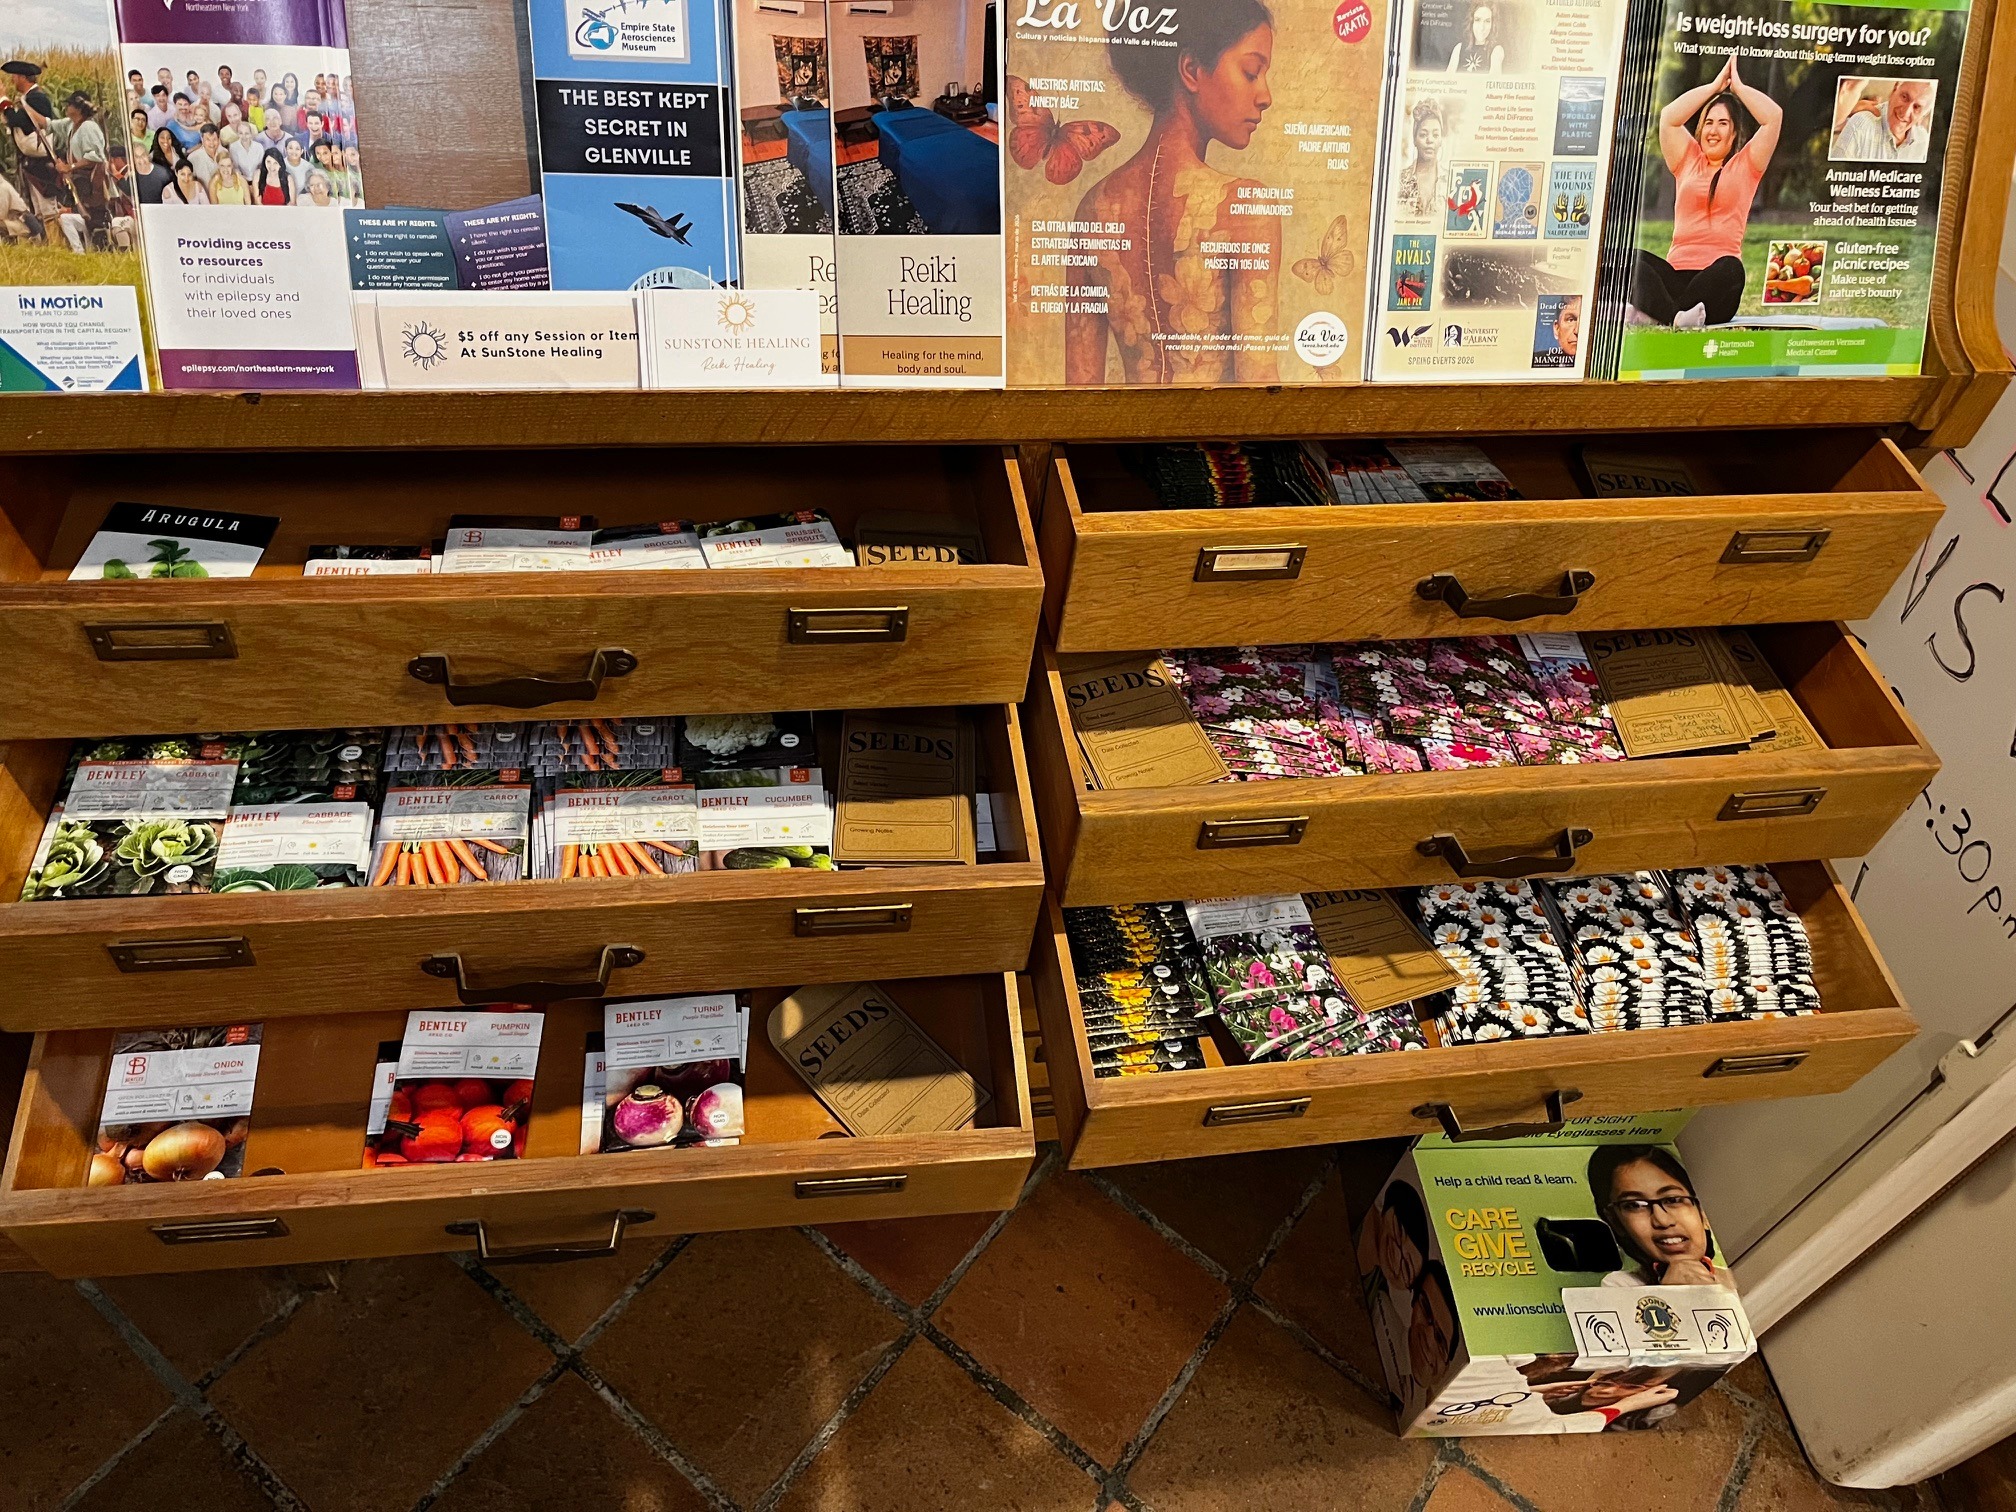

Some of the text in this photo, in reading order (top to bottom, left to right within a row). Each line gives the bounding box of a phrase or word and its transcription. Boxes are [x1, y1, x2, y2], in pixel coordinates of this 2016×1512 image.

[1016, 0, 1179, 35] La Voz
[1338, 12, 1369, 36] GRATIS
[620, 23, 676, 34] Empire State
[1676, 11, 1932, 48] Is weight-loss surgery for you?
[621, 34, 676, 43] Aerosciences
[621, 43, 657, 52] Museum
[558, 88, 710, 110] THE BEST KEPT
[584, 118, 688, 138] SECRET IN
[1284, 121, 1351, 136] SUEÑO AMERICANO:
[1298, 141, 1350, 153] PADRE ARTURO
[585, 147, 691, 166] GLENVILLE
[1327, 158, 1348, 170] ROJAS
[1555, 171, 1594, 180] THE FIVE
[1825, 169, 1922, 183] Annual Medicare
[1554, 182, 1592, 190] WOUNDS
[1830, 185, 1920, 198] Wellness Exams
[358, 219, 381, 227] THESE
[409, 220, 437, 228] RIGHTS.
[1032, 221, 1124, 234] ESA OTRA MITAD DEL CIELO
[177, 238, 291, 250] Providing access
[1032, 238, 1131, 250] ESTRATEGIAS FEMINISTAS EN
[1410, 240, 1419, 248] THE
[1835, 242, 1899, 254] Gluten-free
[180, 256, 263, 267] to resources
[1031, 255, 1098, 266] EL ARTE MEXICANO
[1396, 250, 1430, 265] RIVALS
[900, 255, 957, 282] Reiki
[1833, 259, 1910, 272] picnic recipes
[182, 273, 275, 284] for individuals
[185, 290, 300, 303] with epilepsy and
[887, 288, 972, 322] Healing
[187, 308, 292, 319] their loved ones
[458, 330, 639, 343] $5 off any Session or Item
[1468, 336, 1498, 344] ALBANY
[1788, 338, 1866, 347] Southwestern Vermont
[664, 337, 811, 350] SUNSTONE HEALING
[1720, 340, 1755, 348] Dartmouth
[461, 347, 603, 359] At SunStone Healing
[882, 350, 984, 361] Healing for the mind,
[1718, 348, 1738, 356] Health
[1786, 348, 1838, 356] Medical Center
[733, 357, 776, 375] Healing
[1408, 356, 1475, 365] SPRING EVENTS 2026
[1534, 356, 1574, 364] MANCHIN
[181, 364, 335, 374] epilepsy.com/northeastern-new-york
[897, 364, 966, 375] body and soul.
[141, 510, 240, 531] ARUGULA
[784, 528, 823, 538] BRUSSEL
[786, 534, 826, 544] SPROUTS
[644, 539, 687, 548] BROCCOLI
[715, 538, 762, 552] BENTLEY
[867, 544, 977, 566] SEEDS
[1592, 629, 1697, 660] SEEDS
[1067, 668, 1166, 710] SEEDS
[848, 731, 954, 760] SEEDS
[87, 770, 146, 782] BENTLEY
[398, 794, 451, 807] BENTLEY
[568, 795, 686, 808] BENTLEY CARROT
[701, 795, 812, 808] BENTLEY CUCUMBER
[225, 812, 280, 825] BENTLEY
[616, 1005, 724, 1024] BENTLEY TURNIP
[419, 1021, 530, 1032] BENTLEY PUMPKIN
[799, 998, 890, 1078] SEEDS
[214, 1060, 244, 1069] ONION
[1595, 1116, 1637, 1125] SIGHT
[1547, 1126, 1663, 1140] Eyeglasses Here
[1434, 1174, 1577, 1189] Help a child read & learn.
[1446, 1208, 1522, 1231] CARE
[1454, 1233, 1532, 1260] GIVE
[1460, 1262, 1538, 1277] RECYCLE
